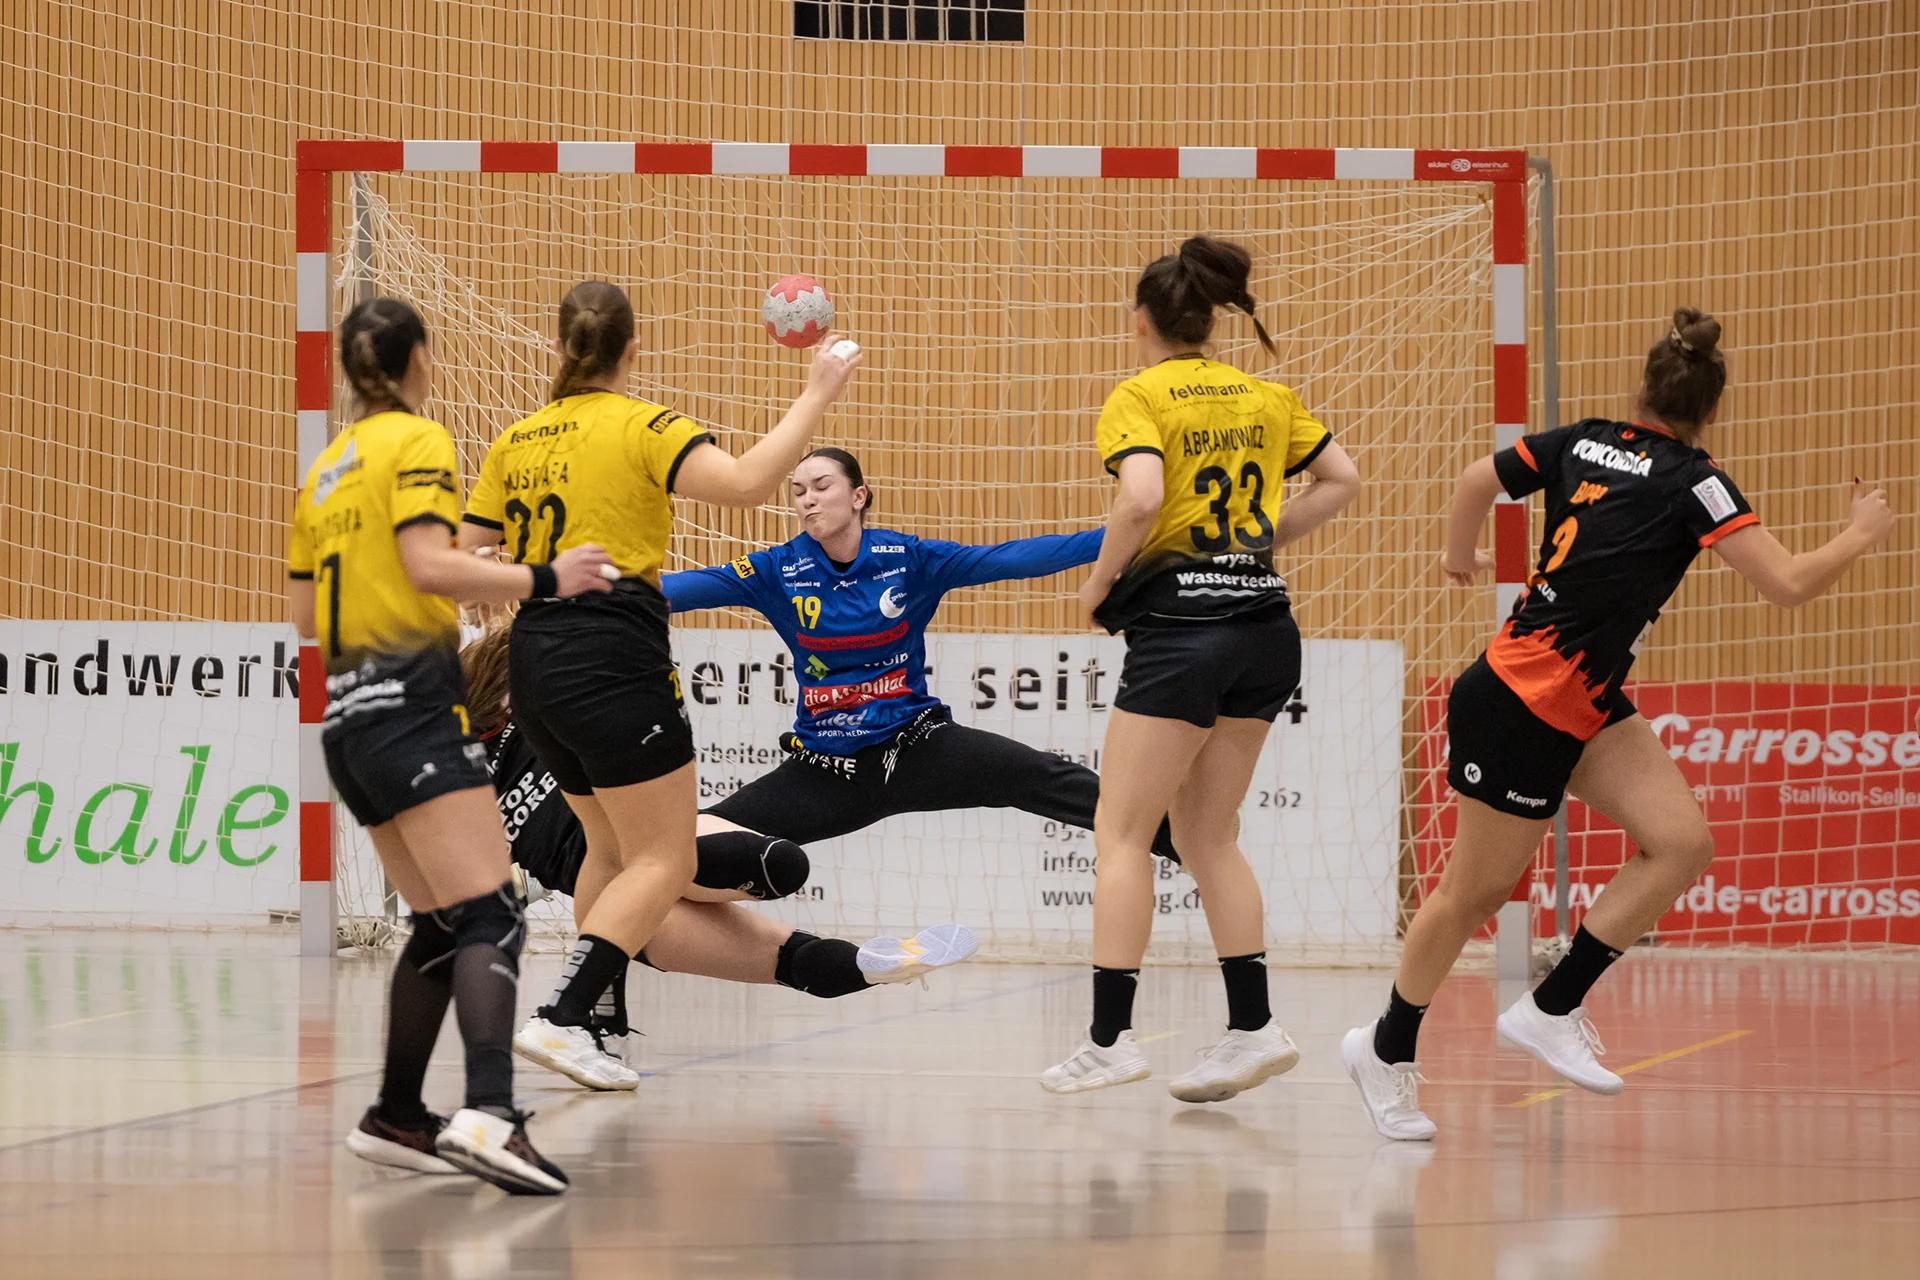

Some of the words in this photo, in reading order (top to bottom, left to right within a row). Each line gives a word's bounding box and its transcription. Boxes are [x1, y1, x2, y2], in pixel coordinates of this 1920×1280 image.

[1191, 461, 1274, 551] 33
[871, 545, 906, 553] SULZER
[1212, 553, 1256, 568] wyss
[792, 595, 821, 629] 19
[0, 639, 299, 698] ndwerk
[673, 653, 794, 705] ert
[971, 651, 1107, 711] seit
[700, 743, 784, 764] rbeiten
[700, 777, 744, 797] beit
[1259, 787, 1302, 808] 262
[1506, 790, 1547, 808] Kempa
[504, 771, 558, 854] CORE
